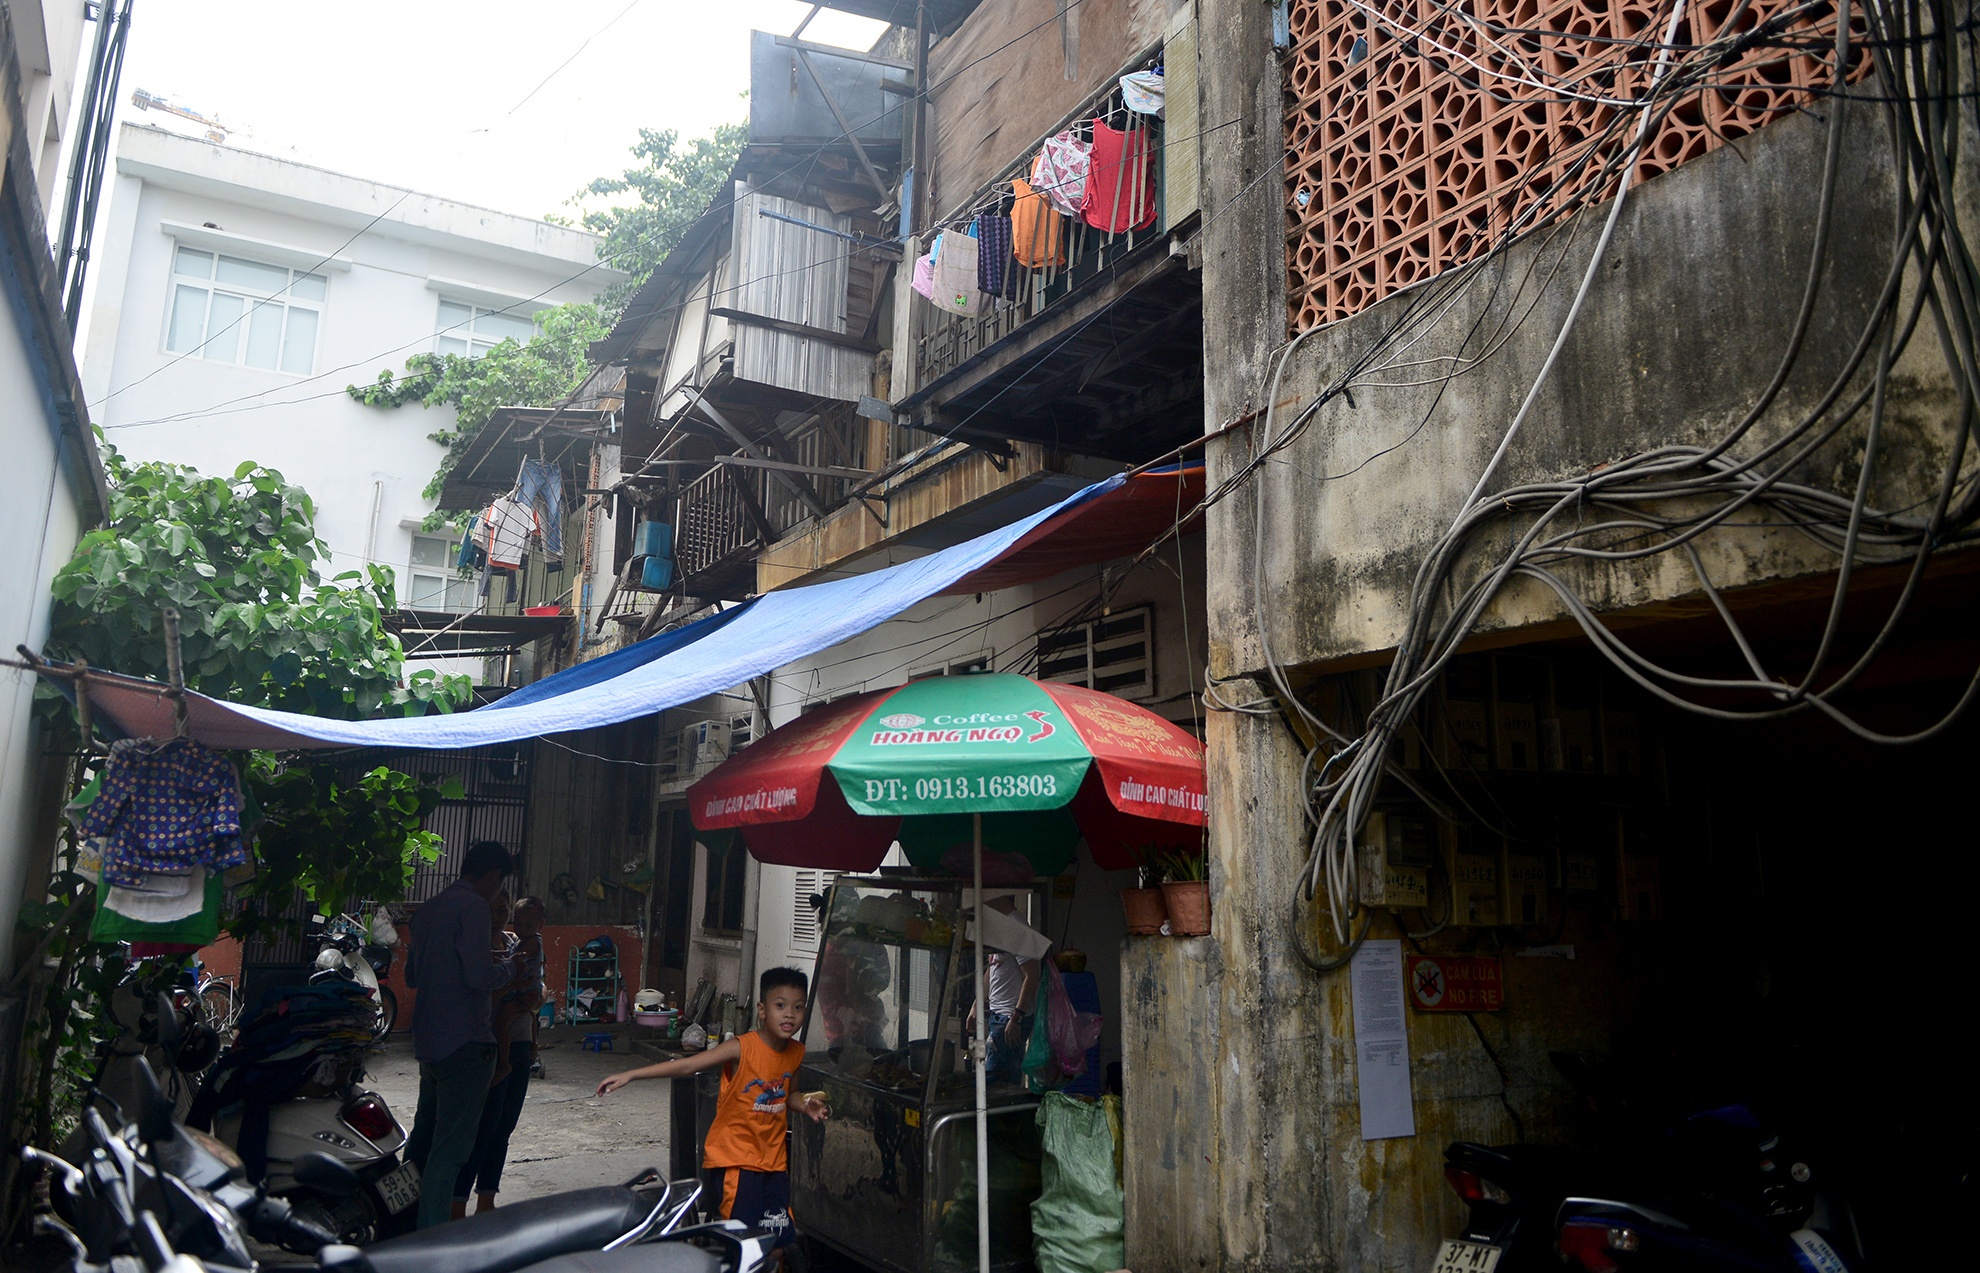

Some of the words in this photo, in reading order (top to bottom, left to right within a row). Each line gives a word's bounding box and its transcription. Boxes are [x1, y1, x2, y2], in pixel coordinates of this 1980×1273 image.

[933, 713, 1018, 725] Coffee
[871, 729, 961, 745] HOÀNG
[967, 727, 1022, 743] NGỌ
[864, 778, 907, 802] ĐT:
[915, 775, 1056, 801] 0913.163803
[1145, 785, 1166, 804] CAO
[1168, 785, 1191, 809] CHẤT
[725, 795, 743, 814] CAO
[743, 787, 766, 811] CHẤT
[1449, 989, 1466, 1004] NO
[1470, 989, 1497, 1005] FIRE
